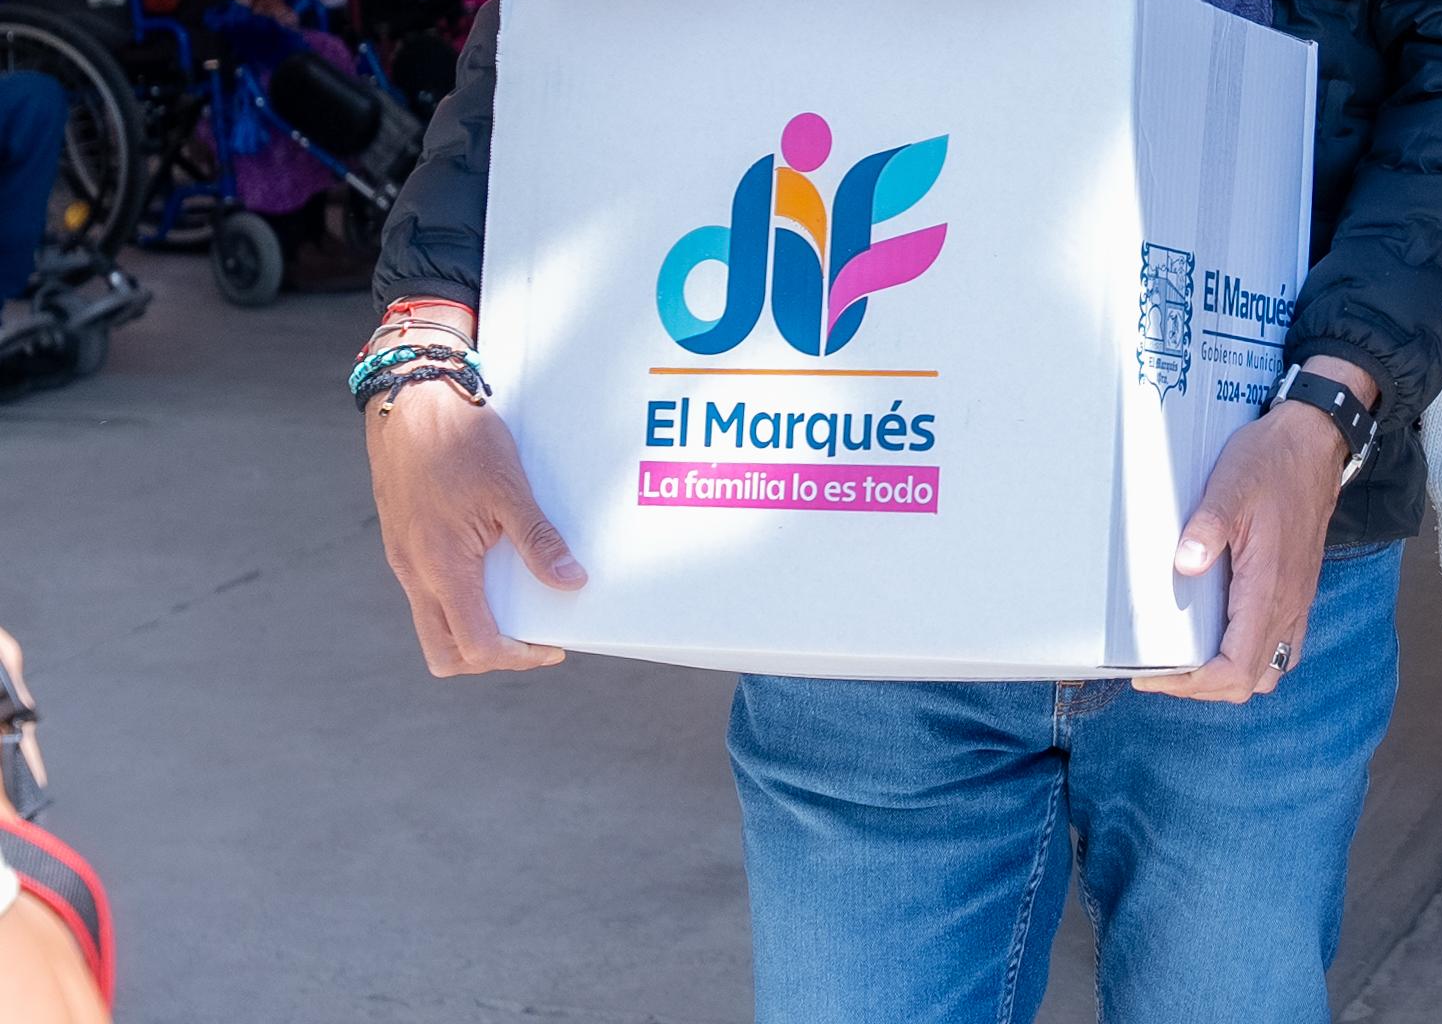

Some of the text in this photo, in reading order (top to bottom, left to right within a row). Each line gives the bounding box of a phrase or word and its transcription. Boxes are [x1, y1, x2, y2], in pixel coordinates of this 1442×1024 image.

[1203, 269, 1295, 338] El Marqués
[1201, 341, 1284, 377] Gobierno Municip
[645, 397, 936, 458] El Marqués
[642, 469, 934, 505] La familia lo es todo
